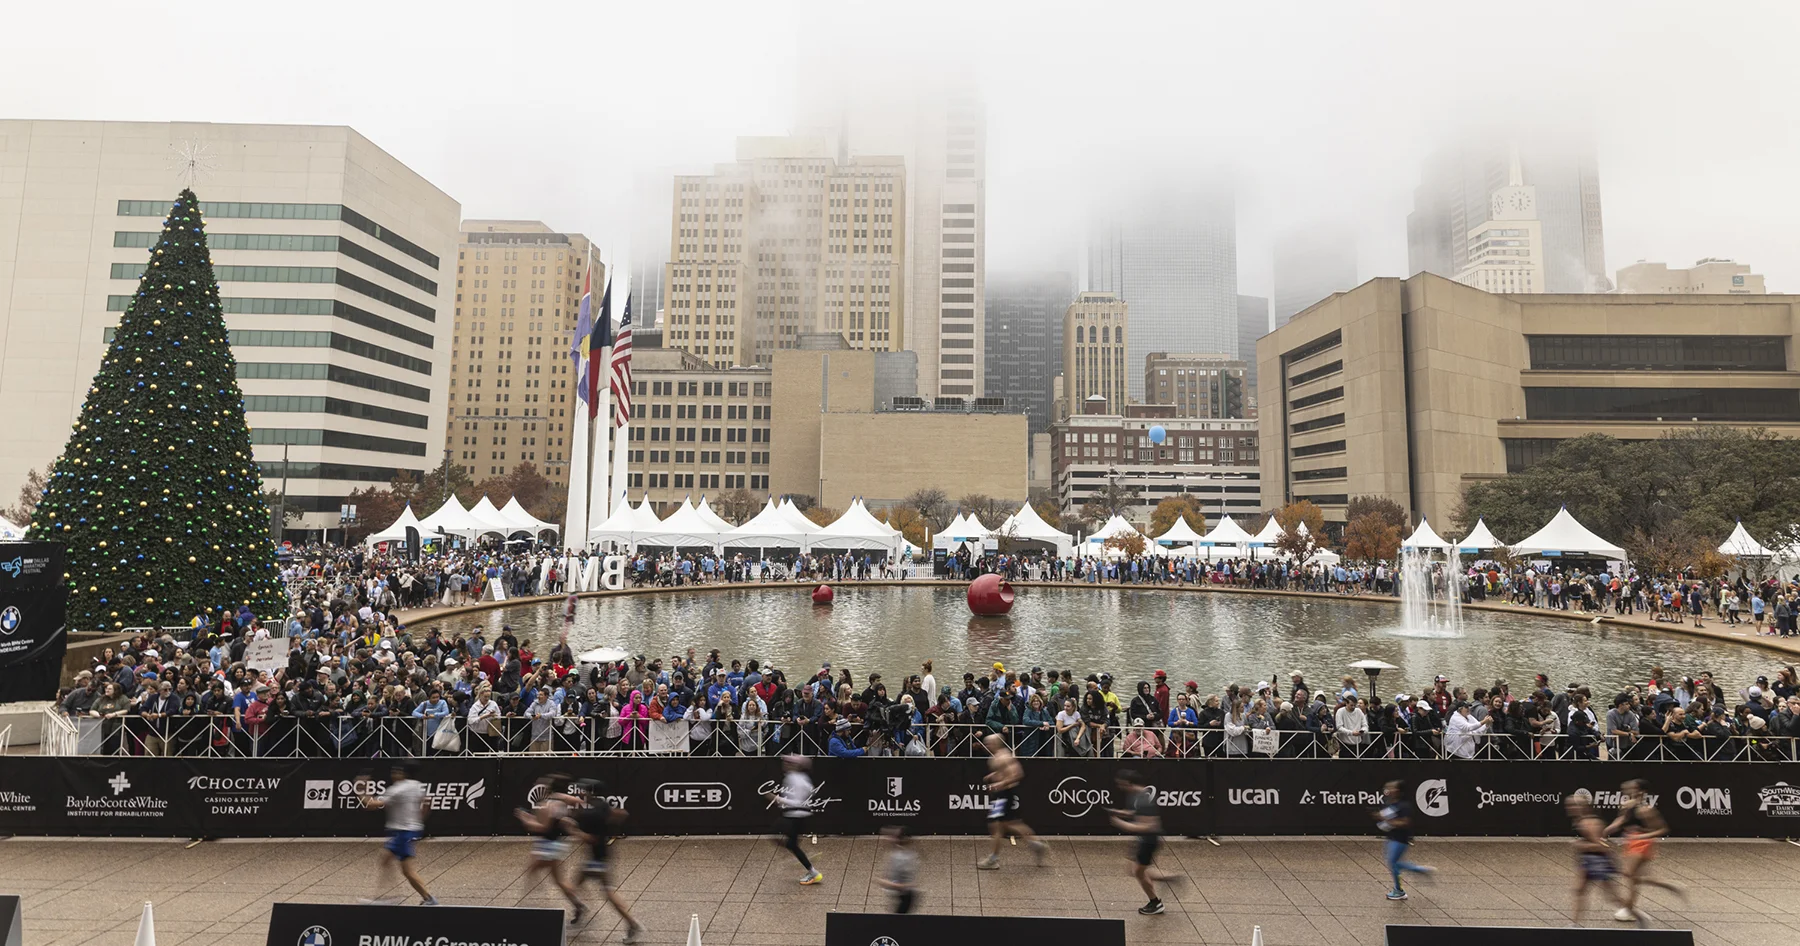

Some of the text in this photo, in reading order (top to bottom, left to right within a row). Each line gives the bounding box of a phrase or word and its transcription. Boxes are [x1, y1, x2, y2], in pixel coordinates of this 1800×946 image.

[196, 776, 281, 790] CHOCTAW
[567, 784, 594, 794] She
[949, 794, 1020, 810] DALLS
[1156, 790, 1202, 807] asics
[1228, 788, 1279, 804] ucan
[1320, 790, 1384, 804] Tetra Pak
[211, 806, 259, 814] DURANT
[420, 797, 463, 810] FEET
[868, 800, 921, 811] DALLAS
[359, 935, 409, 946] BMW
